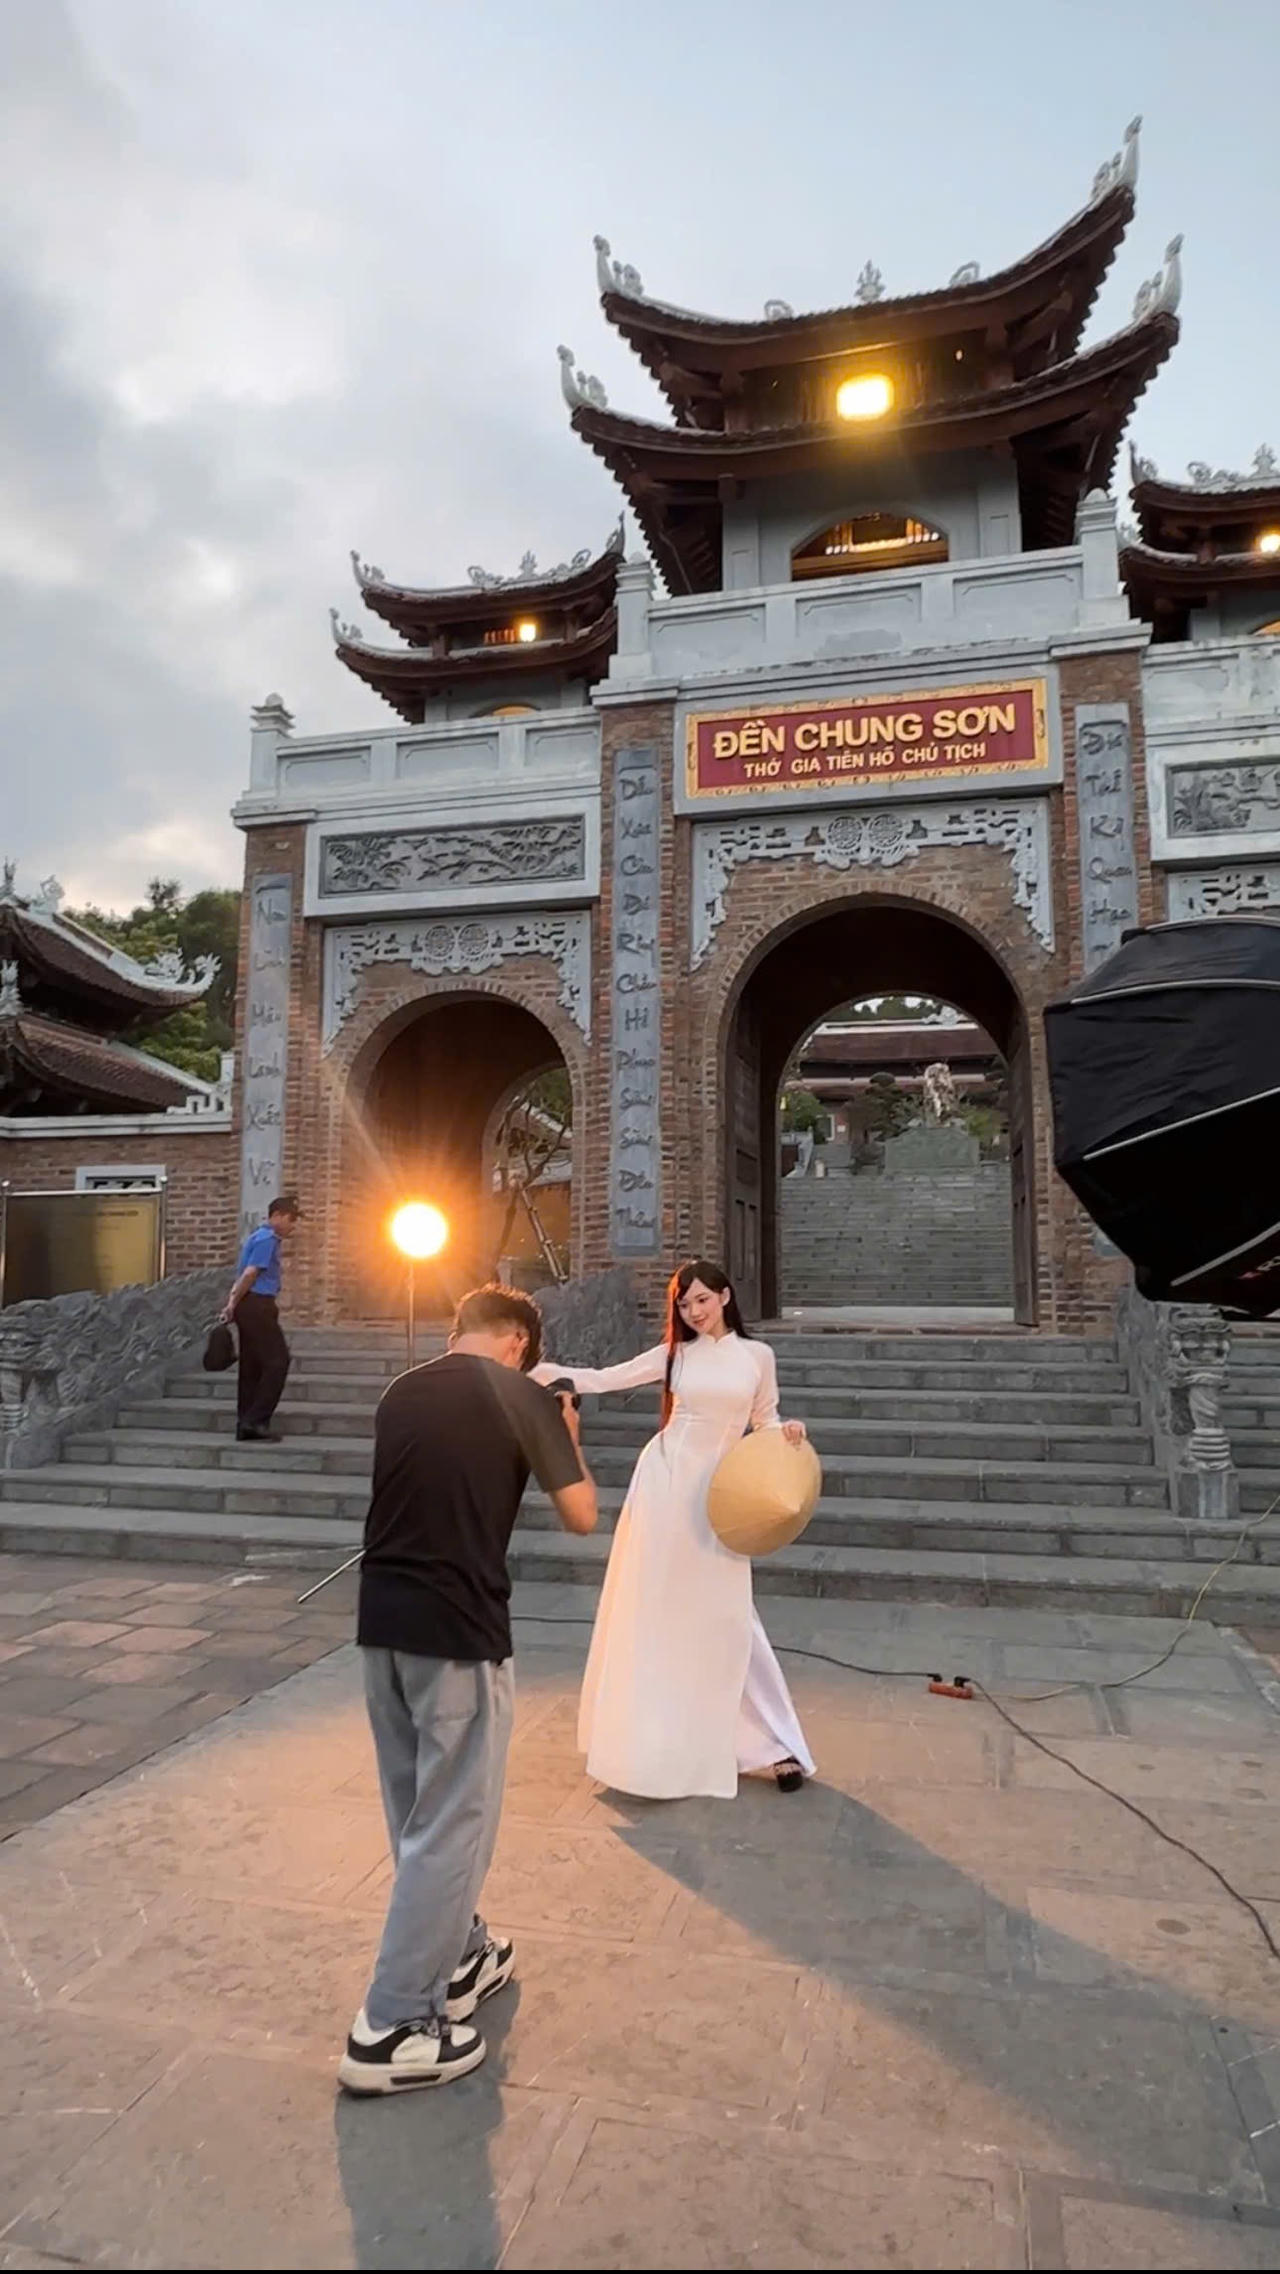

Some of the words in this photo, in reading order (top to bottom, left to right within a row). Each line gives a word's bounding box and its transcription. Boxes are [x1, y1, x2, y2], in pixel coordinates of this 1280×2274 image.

[712, 719, 785, 759] ĐỀN
[794, 713, 924, 752] CHUNG
[933, 703, 1016, 739] SƠN
[791, 757, 822, 775] GIA
[902, 742, 939, 764] CHỦ
[944, 742, 986, 764] TỊCH
